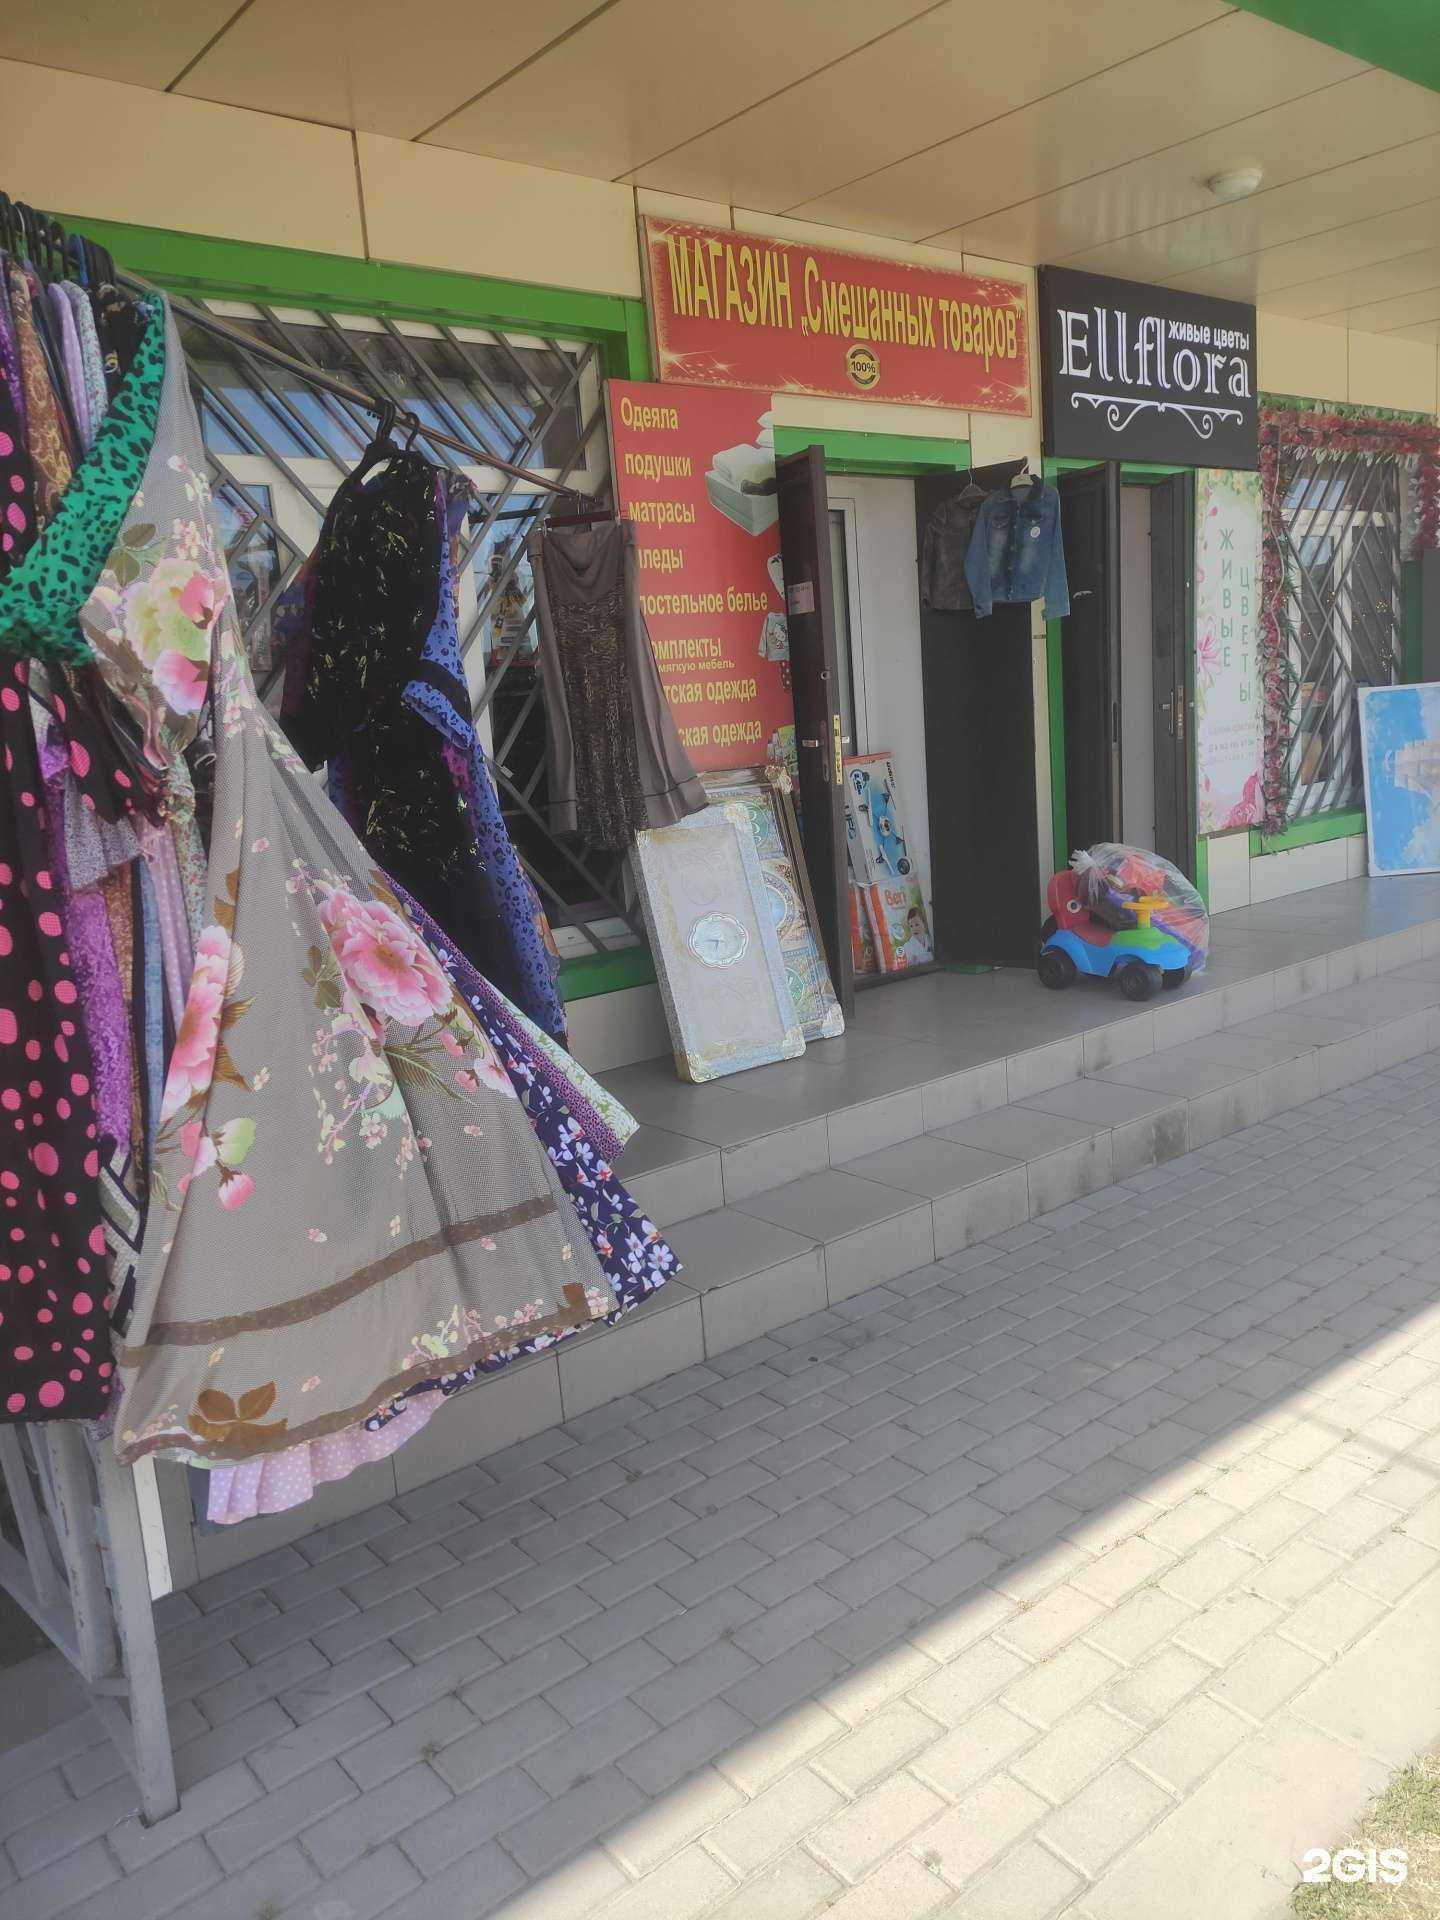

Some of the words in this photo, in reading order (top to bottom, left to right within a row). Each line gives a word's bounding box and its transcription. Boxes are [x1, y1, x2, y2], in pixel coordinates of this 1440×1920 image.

[667, 234, 793, 329] МАГАЗИН
[1056, 306, 1251, 398] Ellflora
[851, 360, 876, 374] 100%
[620, 397, 679, 432] Одеяла
[624, 453, 692, 483] подушки
[628, 501, 695, 529] матрасы
[727, 585, 768, 612] белье
[1220, 529, 1234, 668] ЖИВЫЕ
[1239, 566, 1251, 702] ЦВЕТЫ
[651, 638, 722, 660] омплекты
[698, 658, 735, 670] мебель
[663, 682, 703, 704] тская
[706, 678, 757, 704] одежда
[712, 720, 763, 747] одежда
